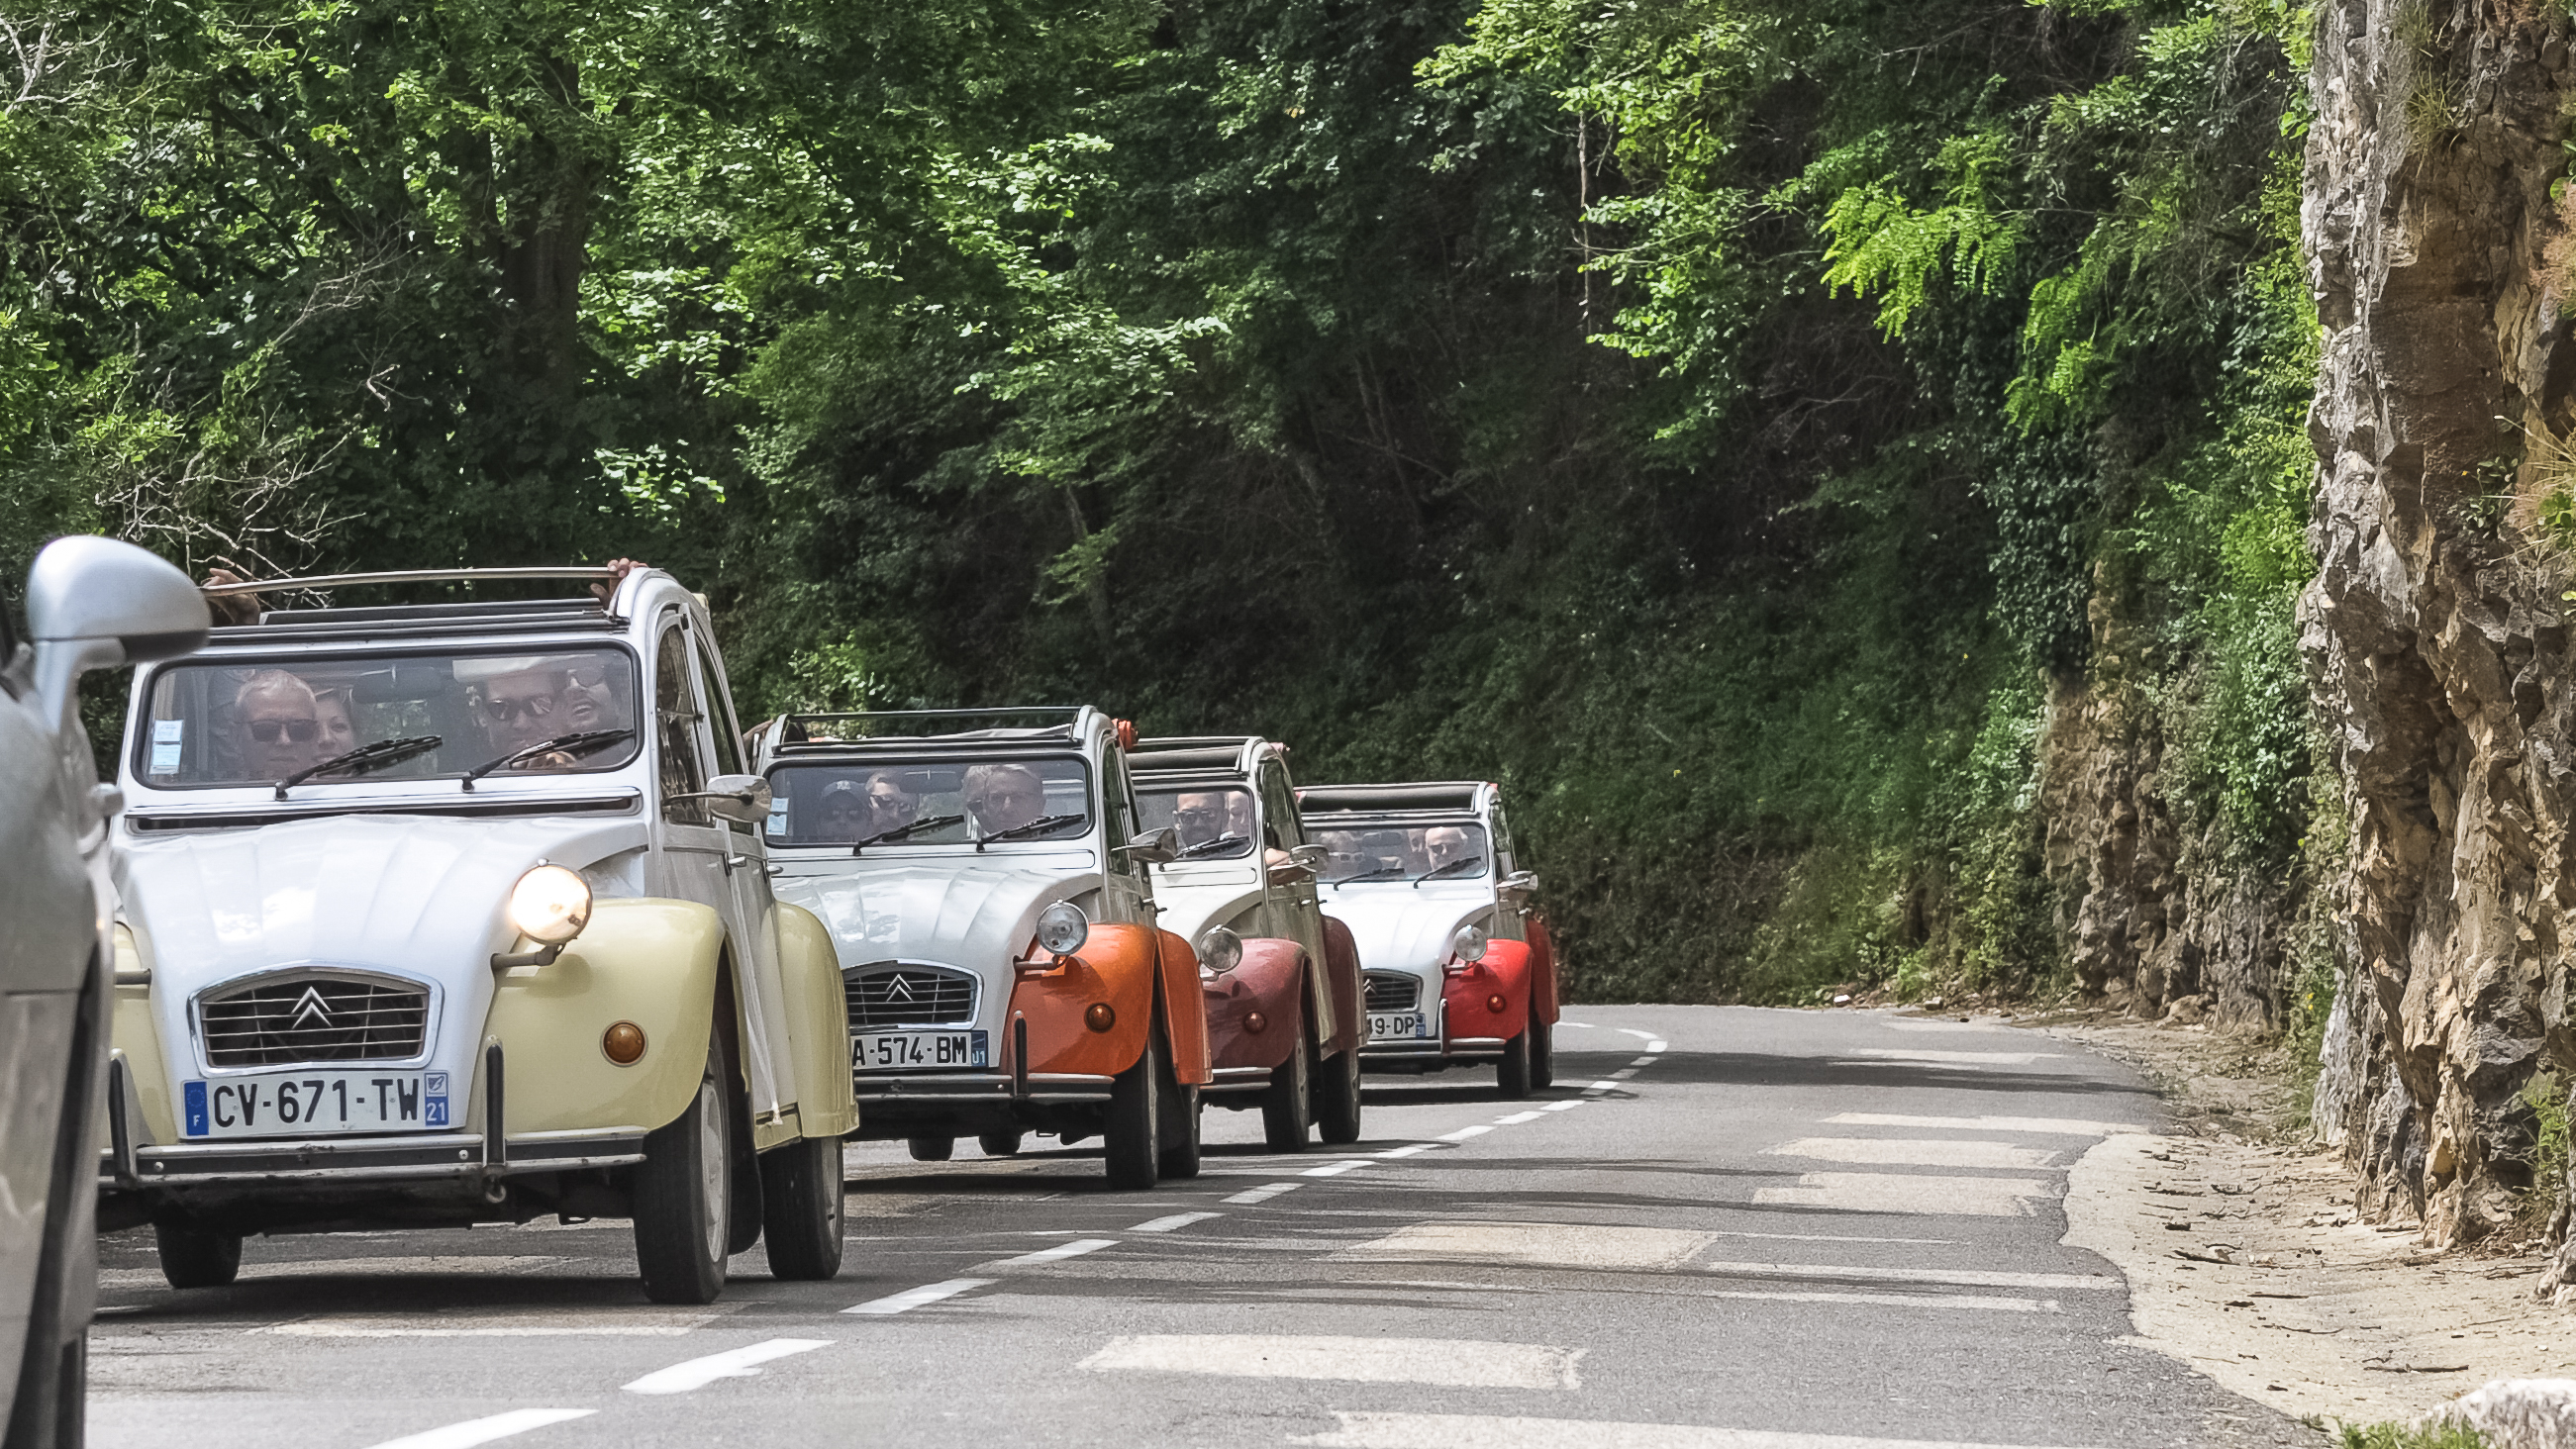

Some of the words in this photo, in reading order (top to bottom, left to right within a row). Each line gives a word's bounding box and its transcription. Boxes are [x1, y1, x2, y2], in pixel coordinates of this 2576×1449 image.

[193, 1114, 200, 1127] F
[213, 1078, 420, 1127] CV-671-TW
[426, 1102, 446, 1122] 21
